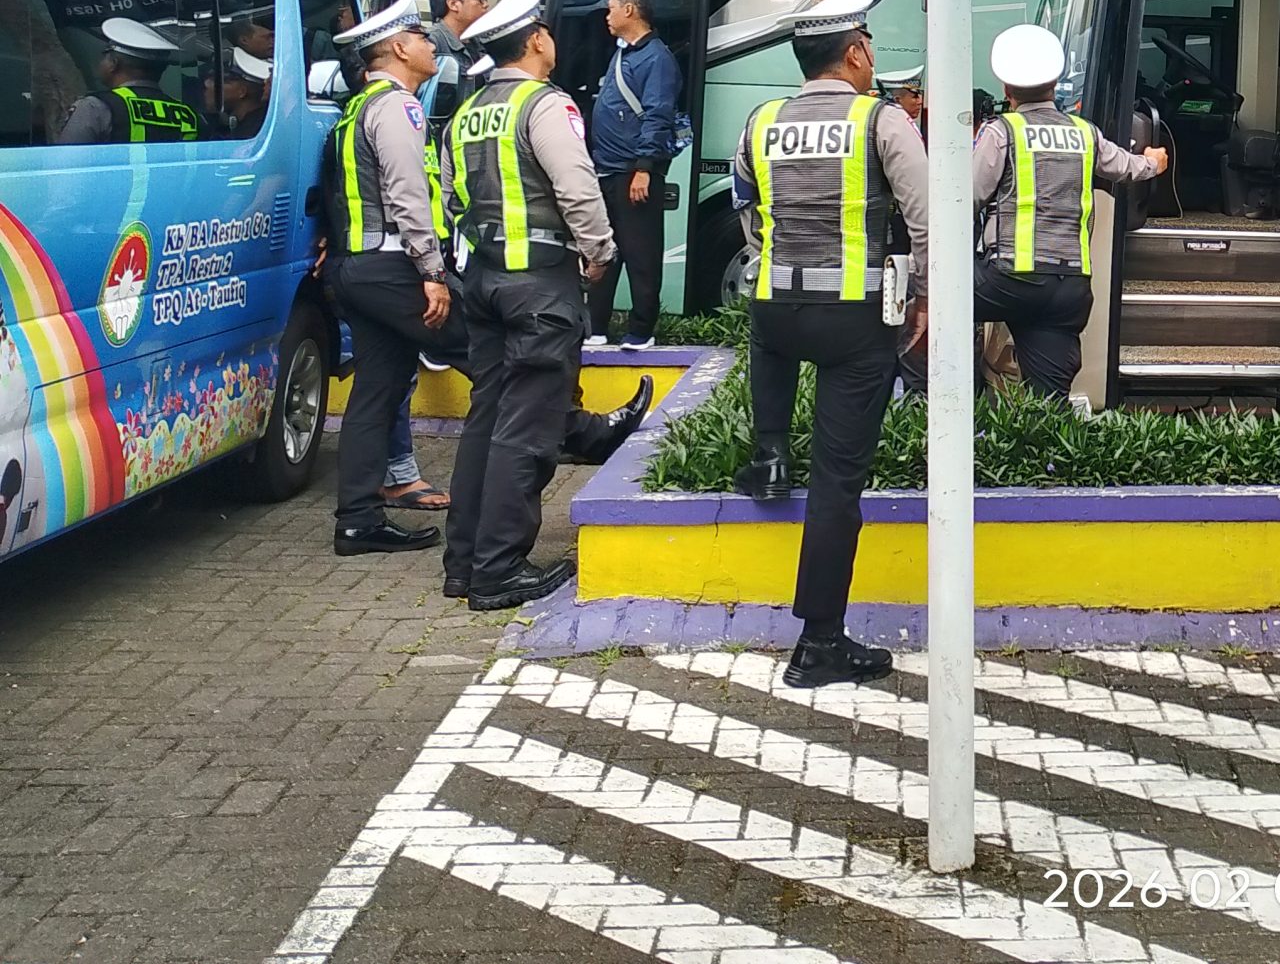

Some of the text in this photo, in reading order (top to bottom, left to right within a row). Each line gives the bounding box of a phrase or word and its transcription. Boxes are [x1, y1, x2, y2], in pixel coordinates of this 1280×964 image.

[765, 123, 853, 157] POLISI
[1025, 127, 1087, 151] POLISI
[208, 218, 244, 248] Restu
[156, 255, 186, 290] TPA
[185, 253, 224, 284] Restu
[153, 290, 183, 326] TPQ
[208, 276, 247, 312] Taufiq
